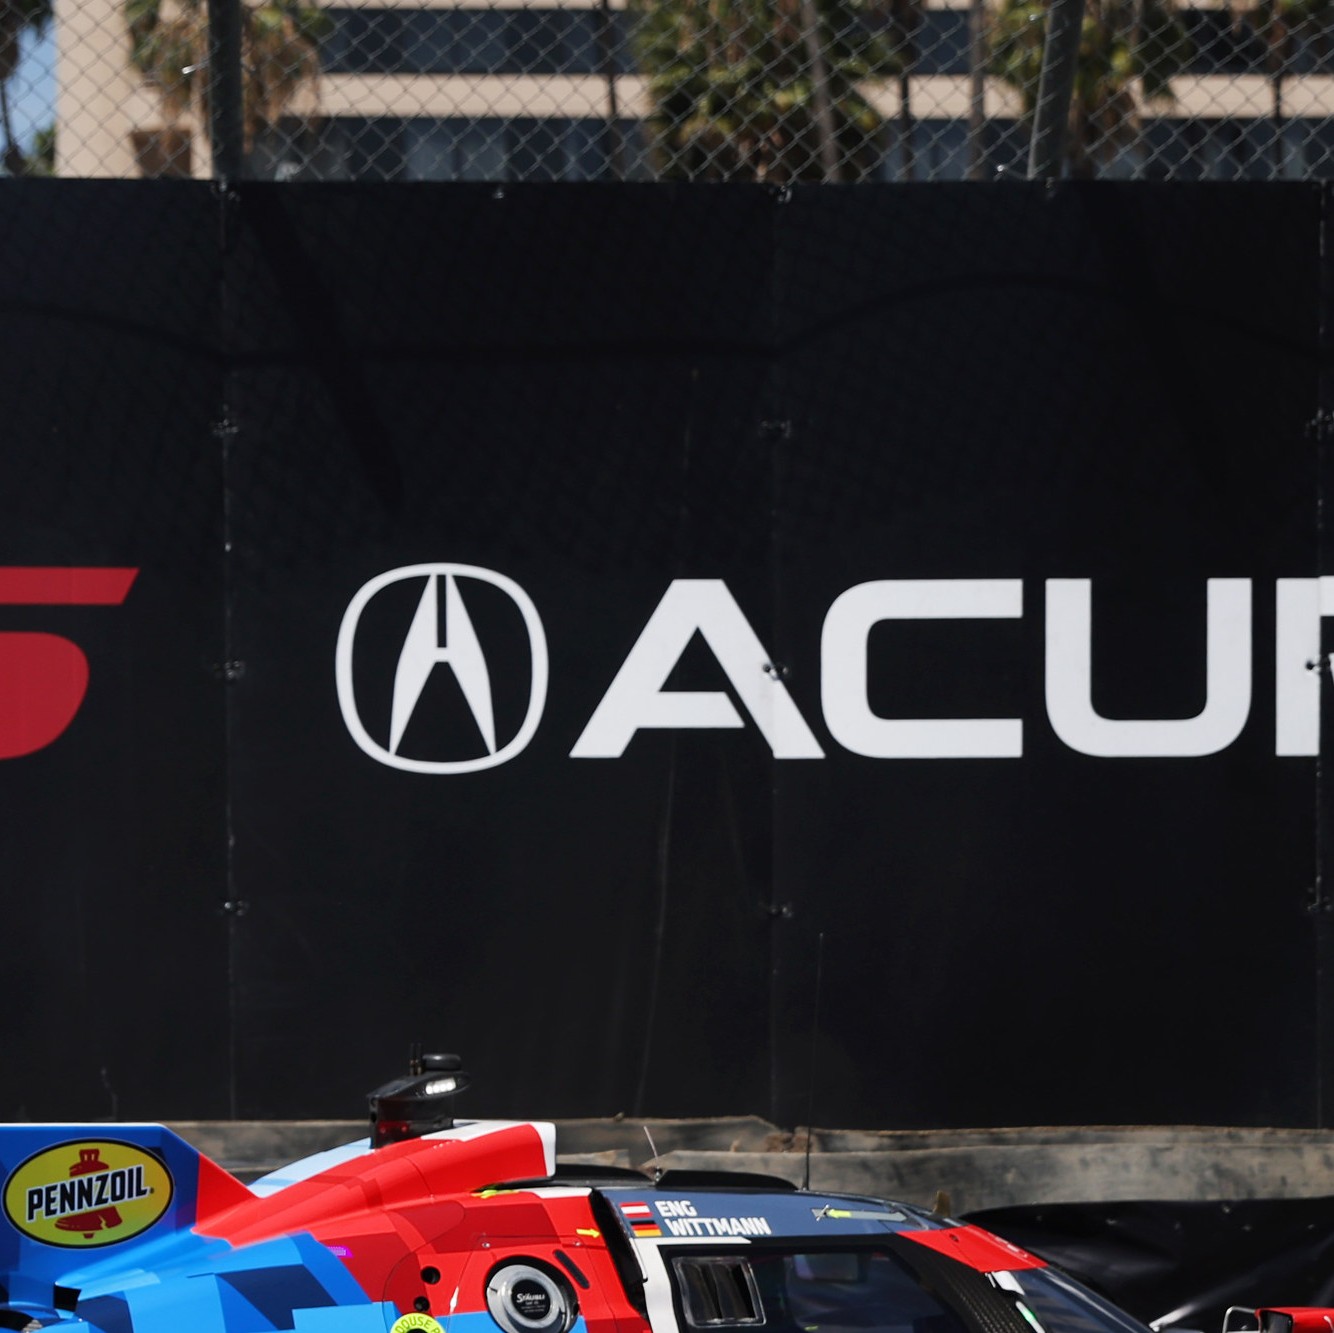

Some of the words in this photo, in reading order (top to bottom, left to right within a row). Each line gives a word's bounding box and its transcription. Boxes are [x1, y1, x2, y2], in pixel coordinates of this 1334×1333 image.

[25, 1163, 149, 1223] PENNZOIL
[654, 1199, 697, 1219] ENG
[665, 1215, 772, 1237] WITTMANN
